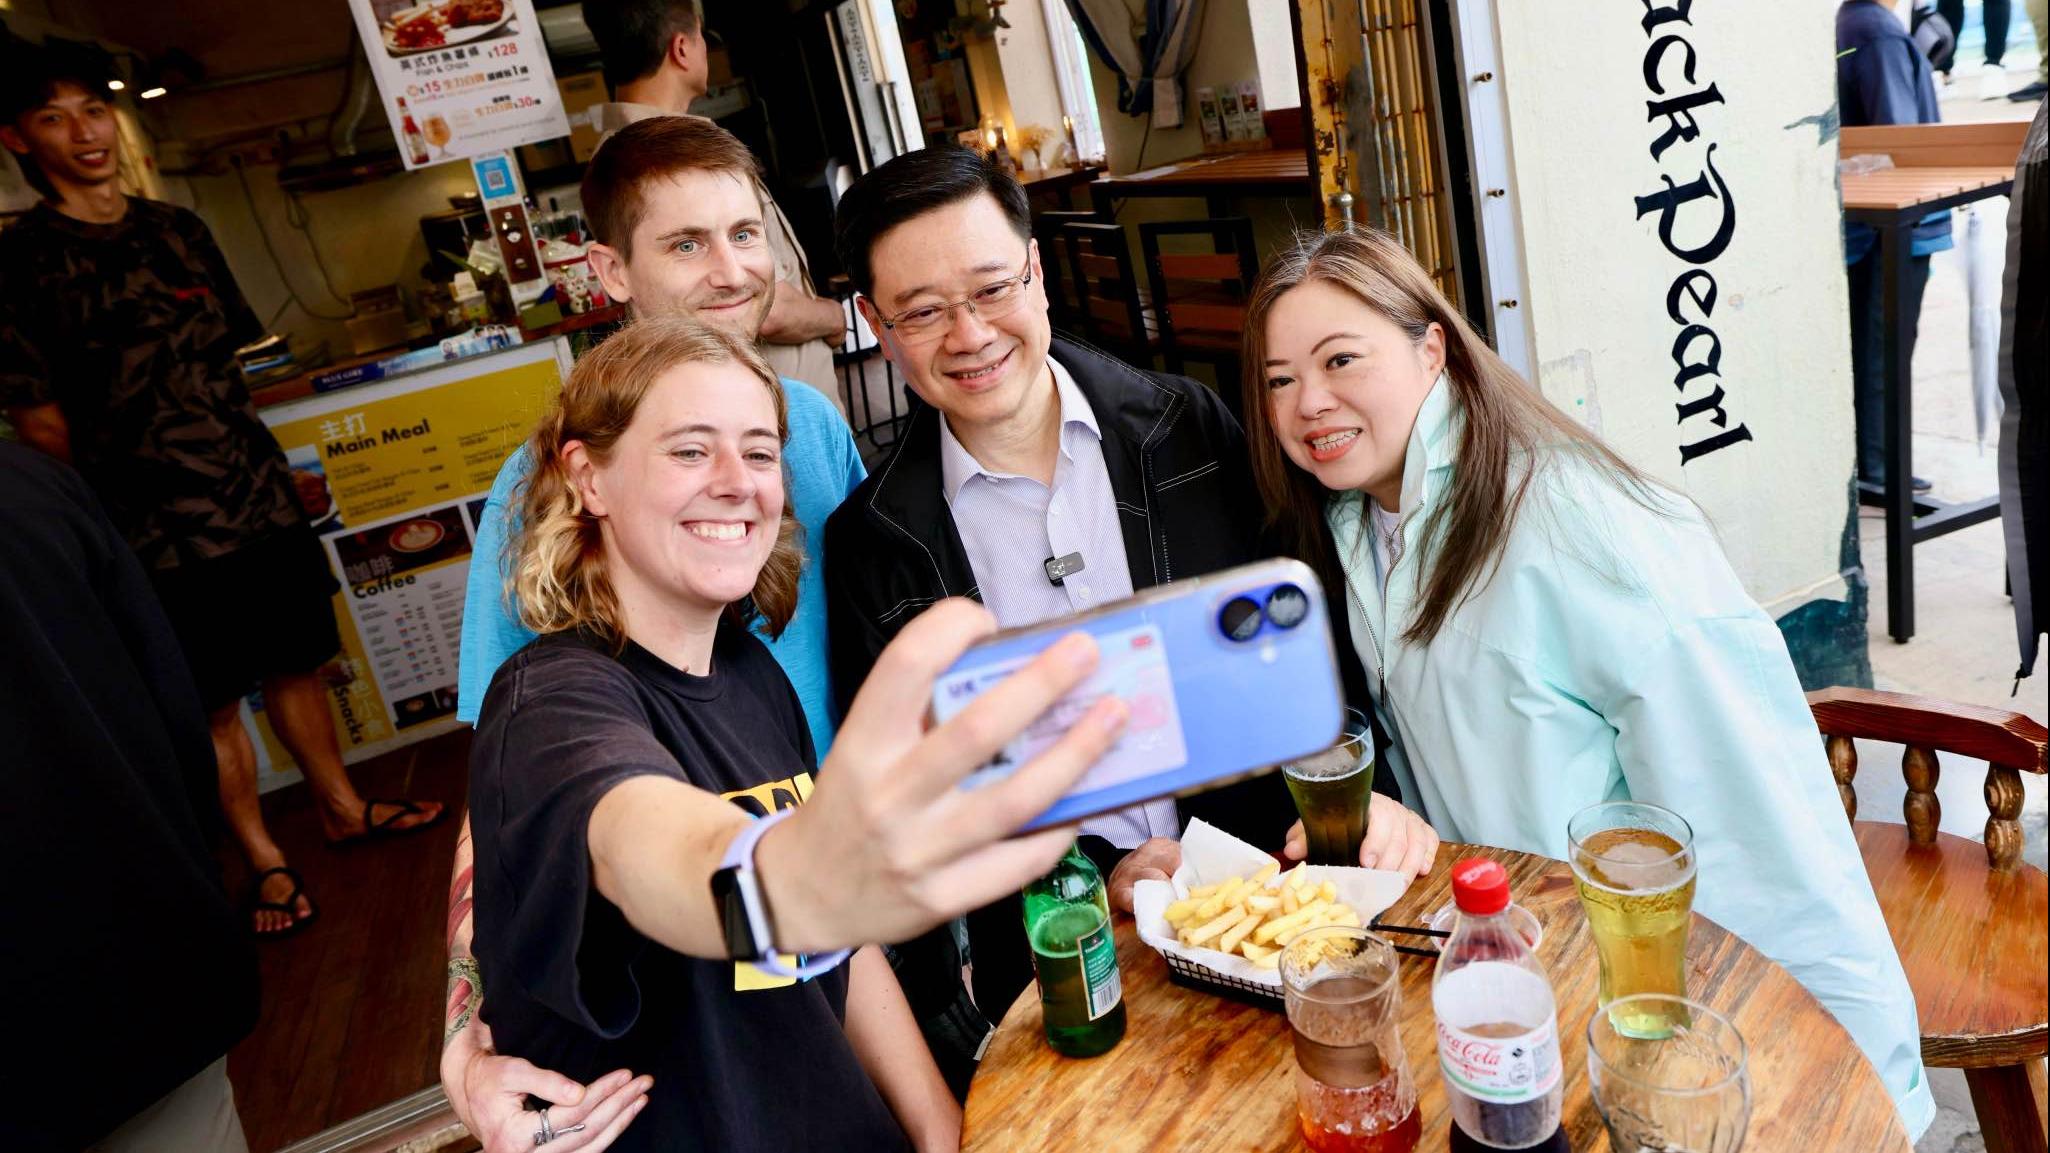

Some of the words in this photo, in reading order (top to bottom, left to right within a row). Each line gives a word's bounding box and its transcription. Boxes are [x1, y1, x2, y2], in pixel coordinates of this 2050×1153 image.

[488, 42, 518, 58] $128
[1634, 142, 1753, 467] Pearl
[319, 412, 368, 442] 主打
[326, 436, 377, 458] Main
[381, 418, 431, 444] Meal
[353, 571, 417, 599] Coffee
[333, 686, 364, 745] Snacks
